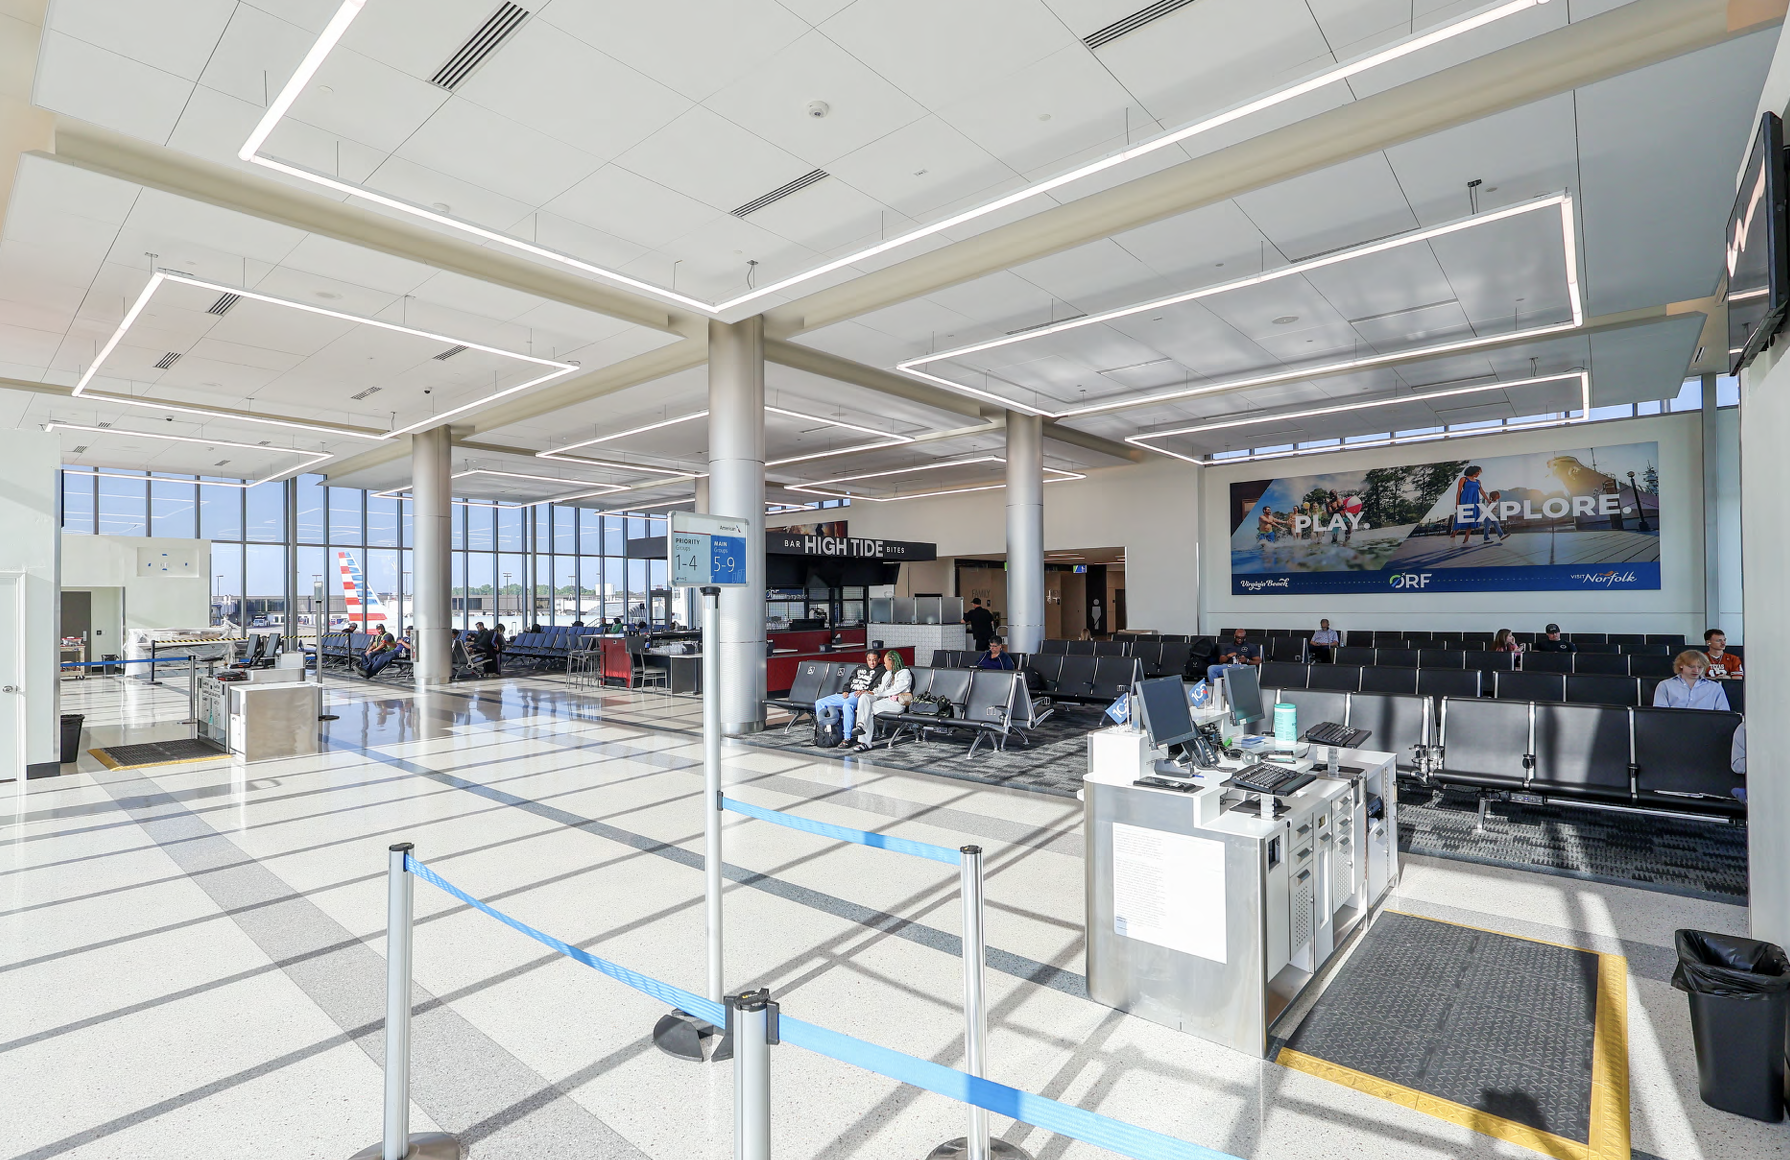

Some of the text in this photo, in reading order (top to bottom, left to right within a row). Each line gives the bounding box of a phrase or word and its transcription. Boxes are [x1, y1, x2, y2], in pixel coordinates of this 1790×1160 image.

[1457, 493, 1632, 523] EXPLORE.
[1295, 511, 1371, 533] PLAY.
[675, 537, 701, 545] PRIORITY
[784, 535, 905, 558] BAR HIGH TIDE BITES
[675, 554, 698, 571] 1-4
[713, 556, 735, 573] 5-9
[1240, 577, 1290, 591] Virginia Beach
[1389, 572, 1433, 589] ORF
[1582, 571, 1638, 588] Norfolk
[971, 588, 991, 599] FAMILY
